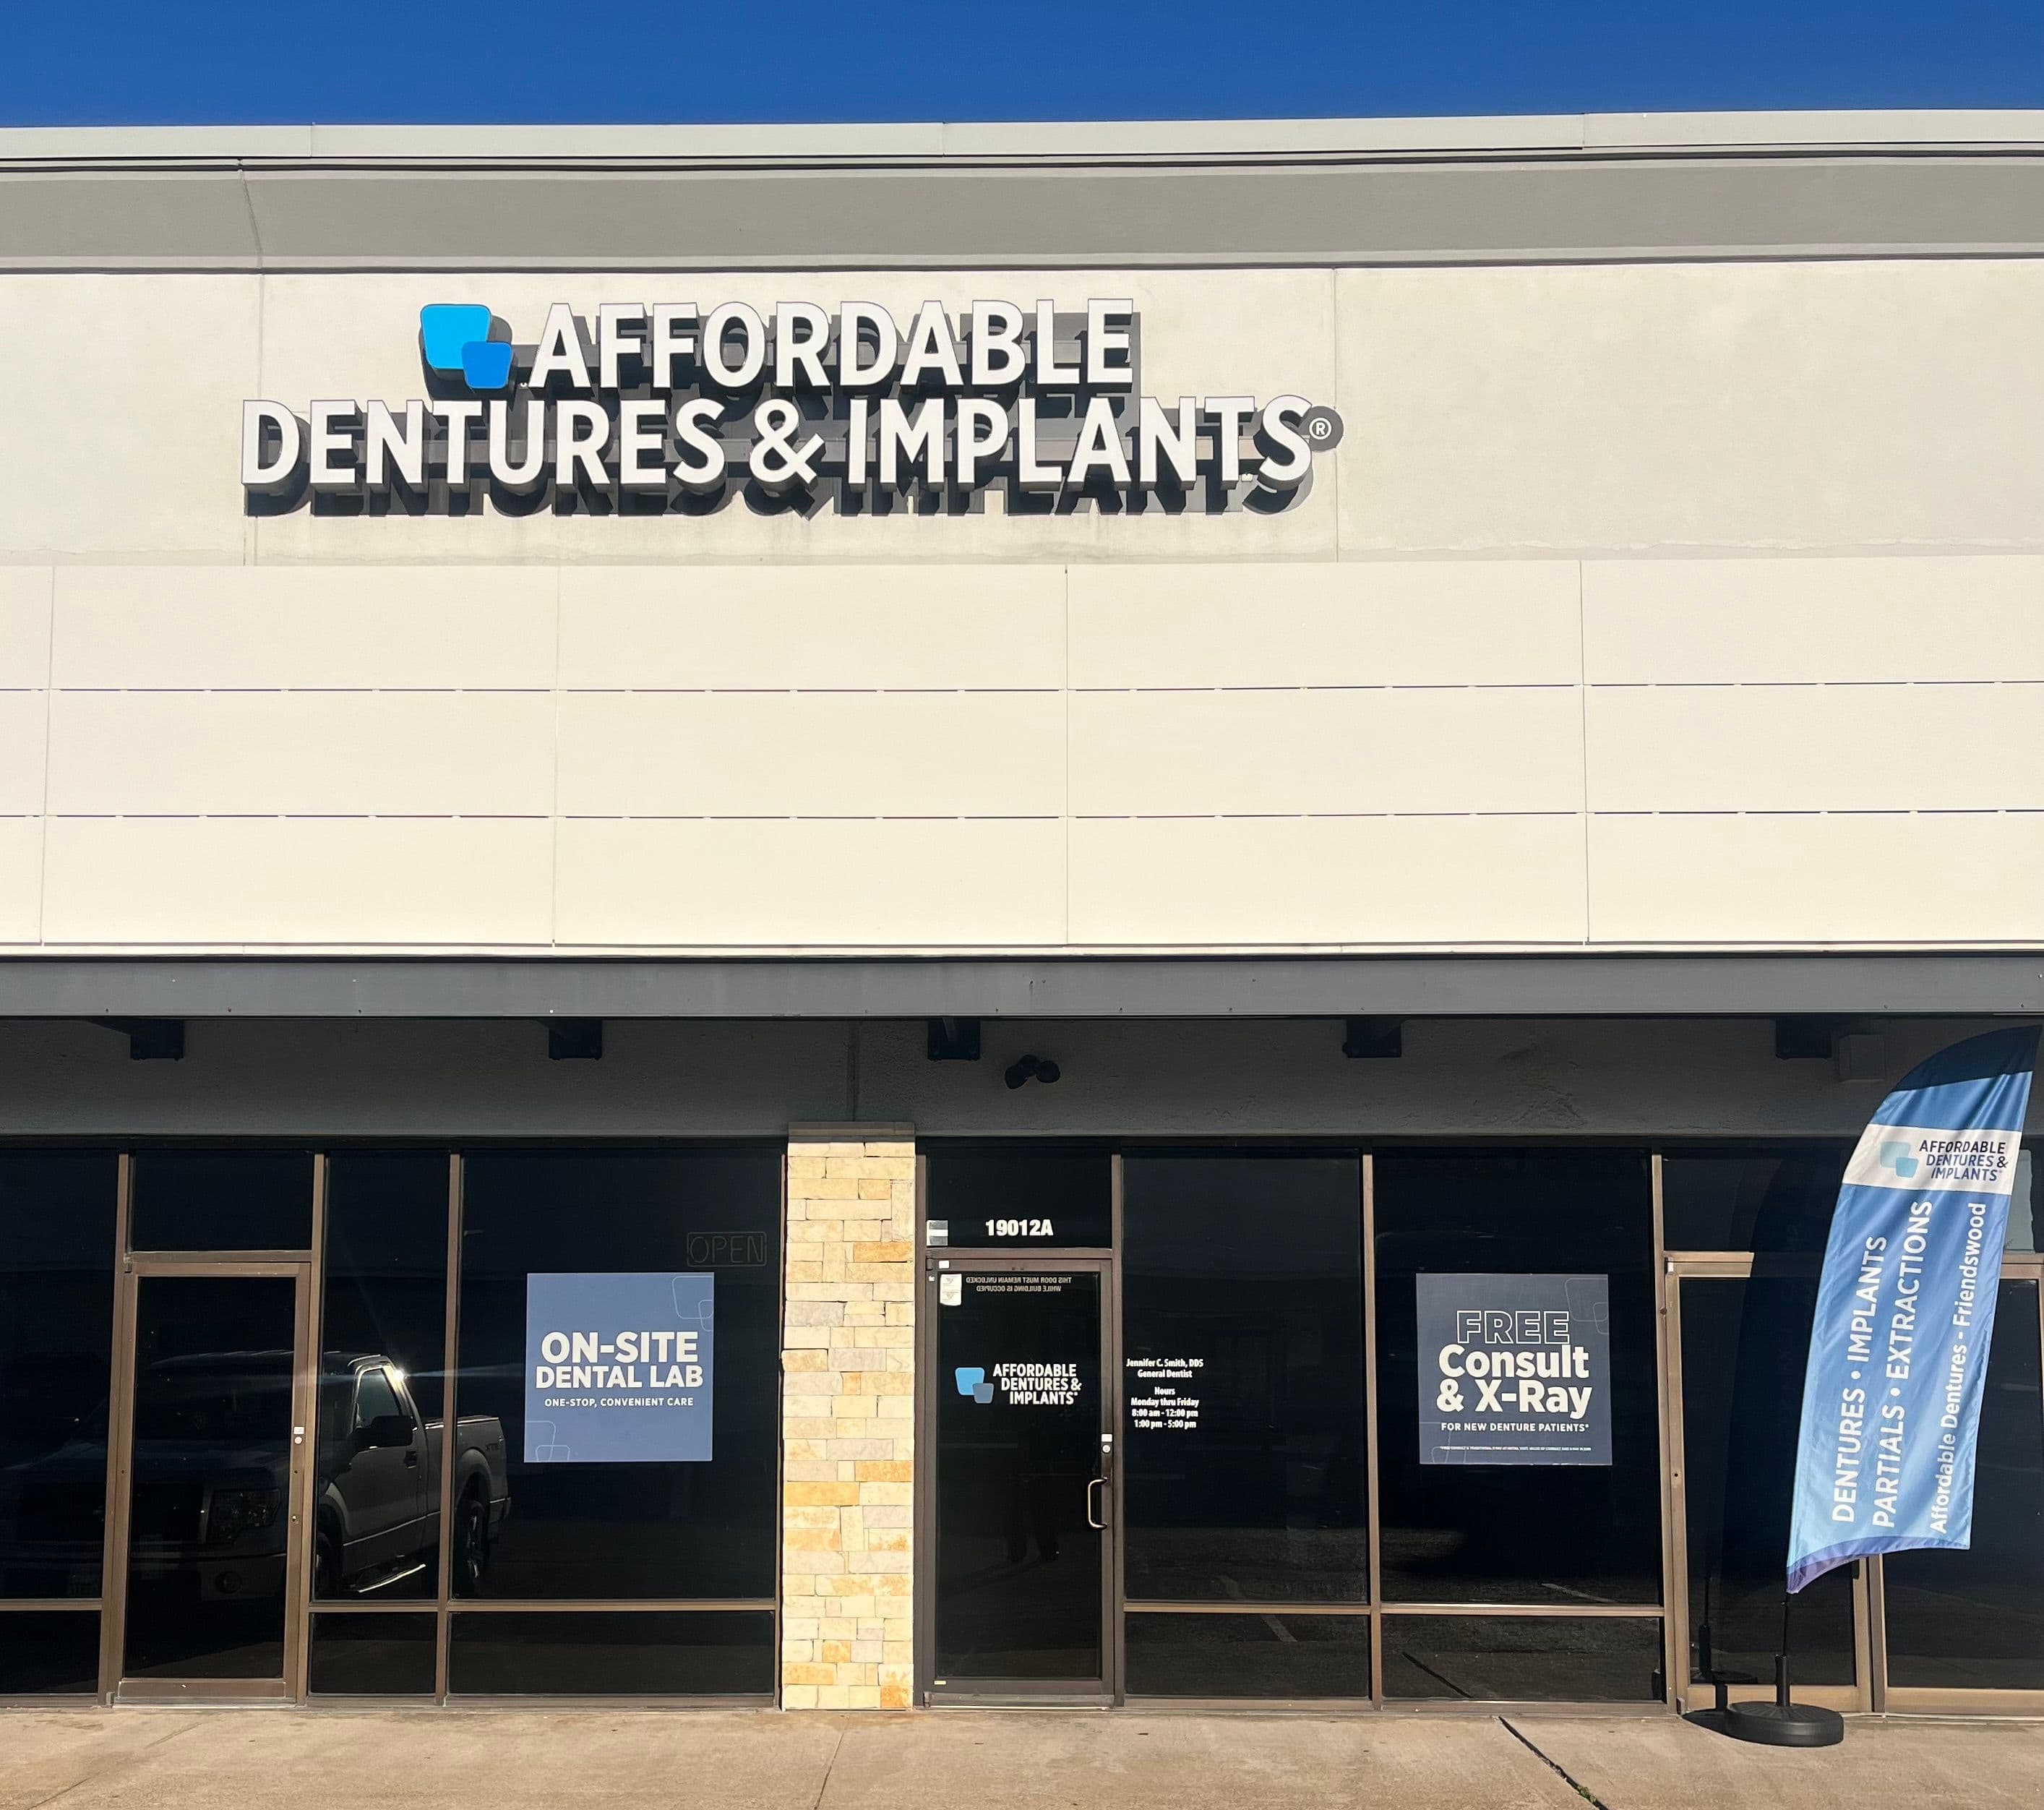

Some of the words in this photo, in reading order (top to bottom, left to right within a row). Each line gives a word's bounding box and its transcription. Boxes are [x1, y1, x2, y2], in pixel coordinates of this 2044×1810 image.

[528, 298, 1133, 388] AFFORDABLE
[241, 399, 726, 485] DENTURES
[750, 399, 825, 485] &
[1919, 1140, 2006, 1154] AFFORDABLE
[1926, 1154, 1994, 1167] DENTURES
[1997, 1157, 2009, 1168] &
[985, 1219, 1054, 1236] 19012A
[690, 1235, 763, 1264] OPEN
[1953, 1203, 1986, 1326] Friendswood
[1847, 1236, 1887, 1362] IMPLANTS
[1886, 1201, 1932, 1379] EXTRACTIONS
[1456, 1310, 1569, 1344] FREE
[541, 1331, 698, 1364] ON-SITE
[1438, 1344, 1589, 1378] Consult
[536, 1365, 643, 1389] DENTAL
[650, 1365, 704, 1388] LAB
[993, 1363, 1076, 1376] AFFORDABLE
[1126, 1358, 1156, 1367] Jennifer
[1164, 1359, 1188, 1368] Smith,
[1001, 1378, 1068, 1391] DENTURES
[1070, 1378, 1082, 1391] &
[1154, 1386, 1175, 1395] Hours
[1436, 1378, 1464, 1412] &
[1474, 1379, 1592, 1420] X-Ray
[1941, 1344, 1967, 1429] Dentures
[545, 1398, 597, 1407] ONE-STOP,
[601, 1397, 664, 1407] CONVENIENT
[667, 1397, 694, 1406] CARE
[1130, 1397, 1159, 1407] Monday
[1160, 1397, 1176, 1406] thru
[1177, 1398, 1199, 1408] Friday
[1186, 1410, 1198, 1419] pm
[1151, 1420, 1162, 1429] pm
[1185, 1420, 1196, 1429] pm
[1441, 1423, 1461, 1431] FOR
[1464, 1423, 1487, 1431] NEW
[1490, 1423, 1535, 1431] DENTURE
[1832, 1388, 1865, 1522] DENTURES
[1873, 1404, 1905, 1527] PARTIALS
[1929, 1433, 1956, 1534] Affordable
